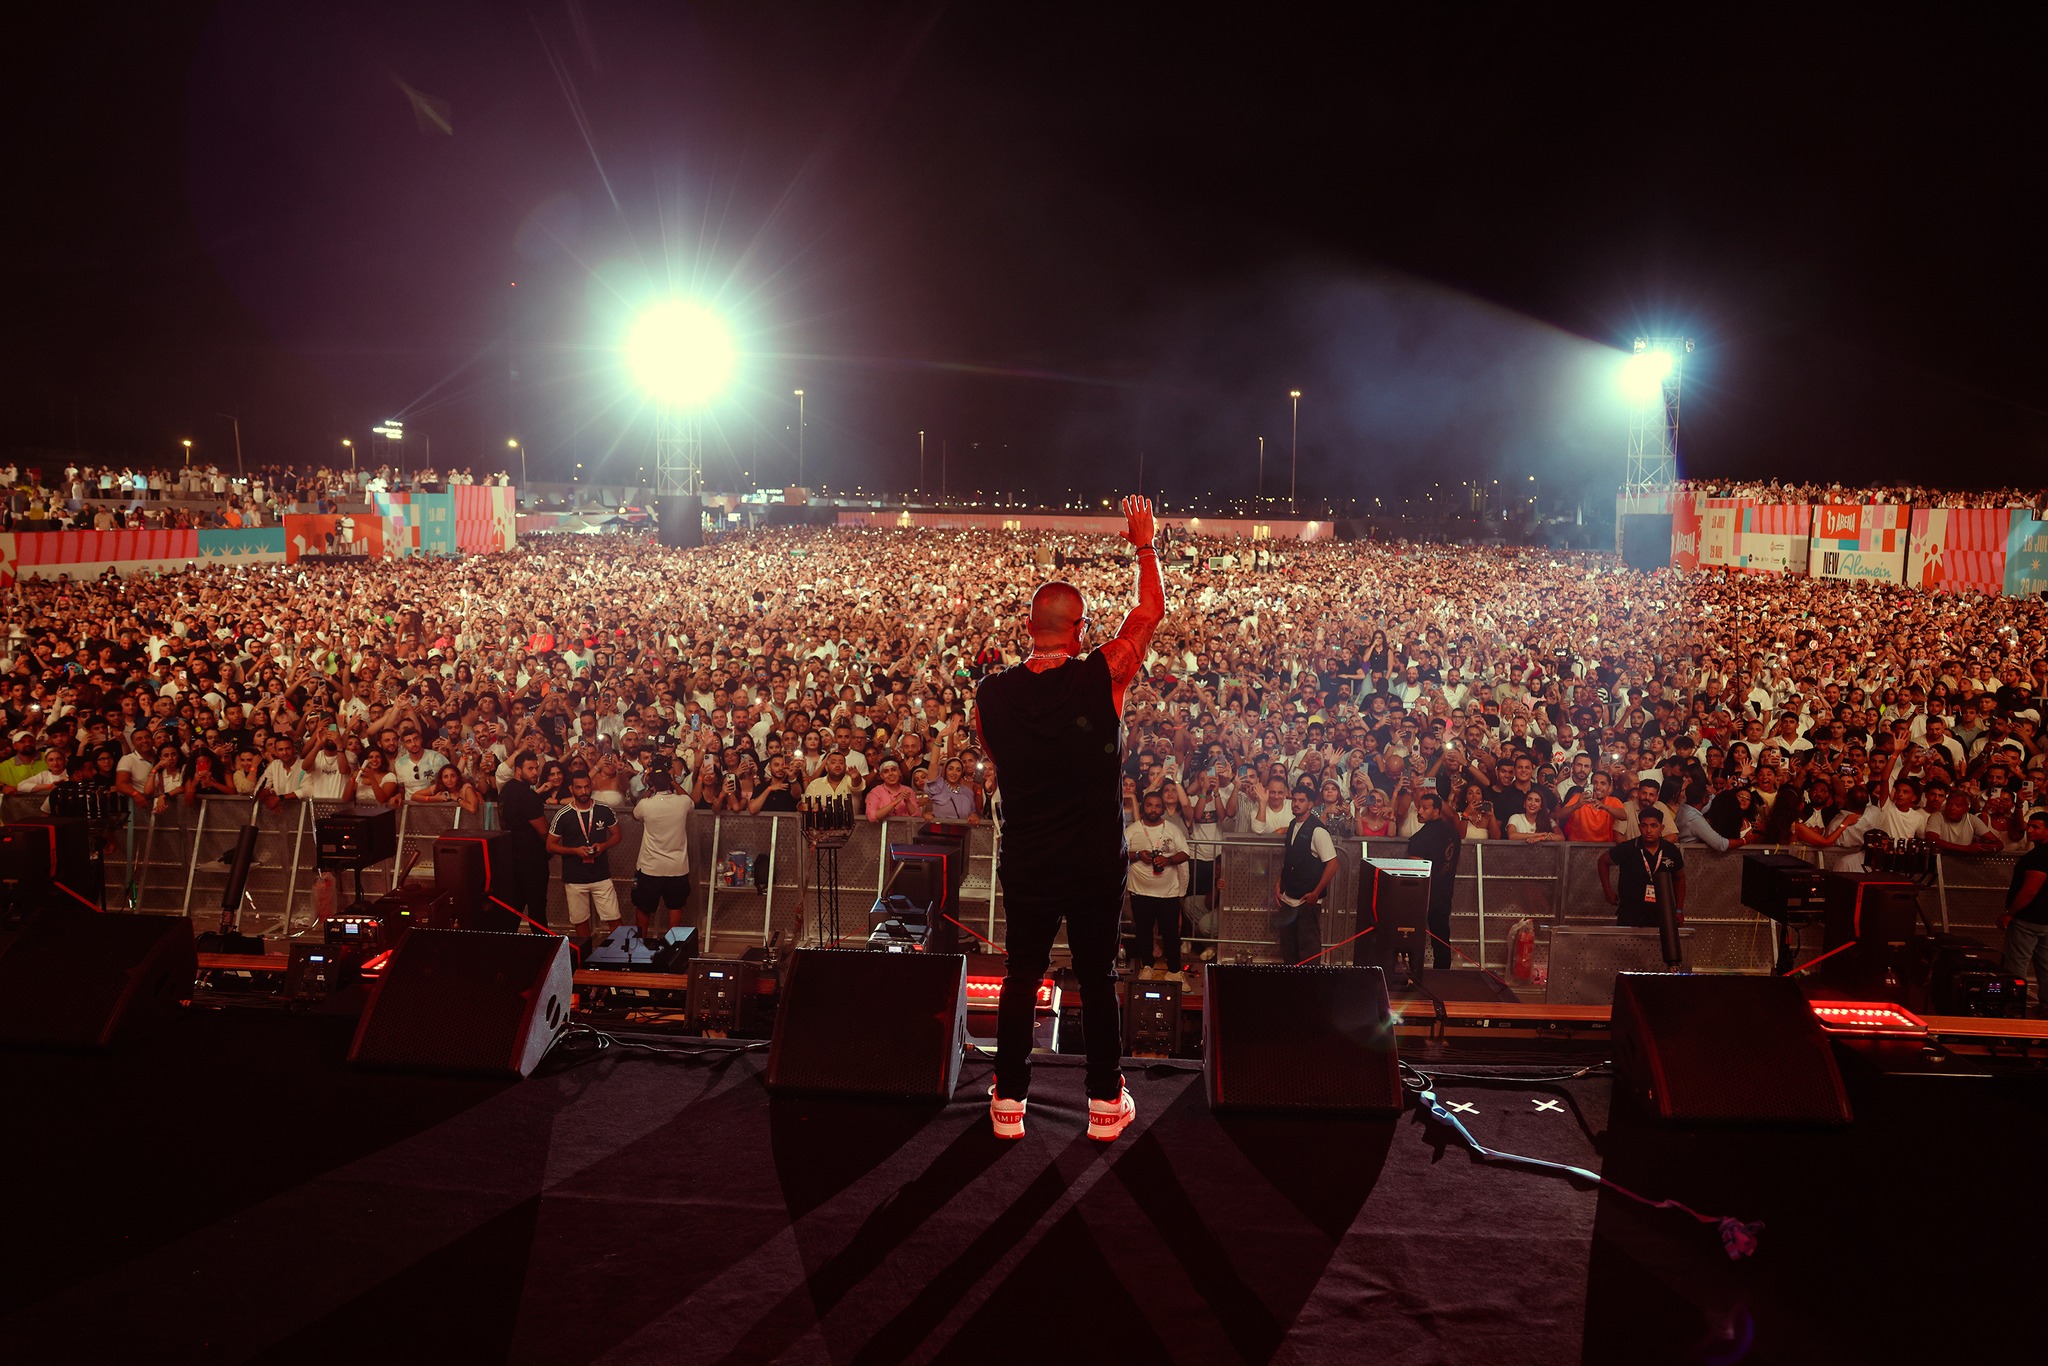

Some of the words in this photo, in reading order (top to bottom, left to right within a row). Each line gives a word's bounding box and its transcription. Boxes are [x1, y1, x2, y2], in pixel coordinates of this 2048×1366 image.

[1835, 512, 1856, 533] ARENA
[1675, 531, 1696, 557] ARENA
[2023, 534, 2033, 552] 18
[1822, 551, 1840, 575] NEW
[1839, 553, 1892, 578] Alamein
